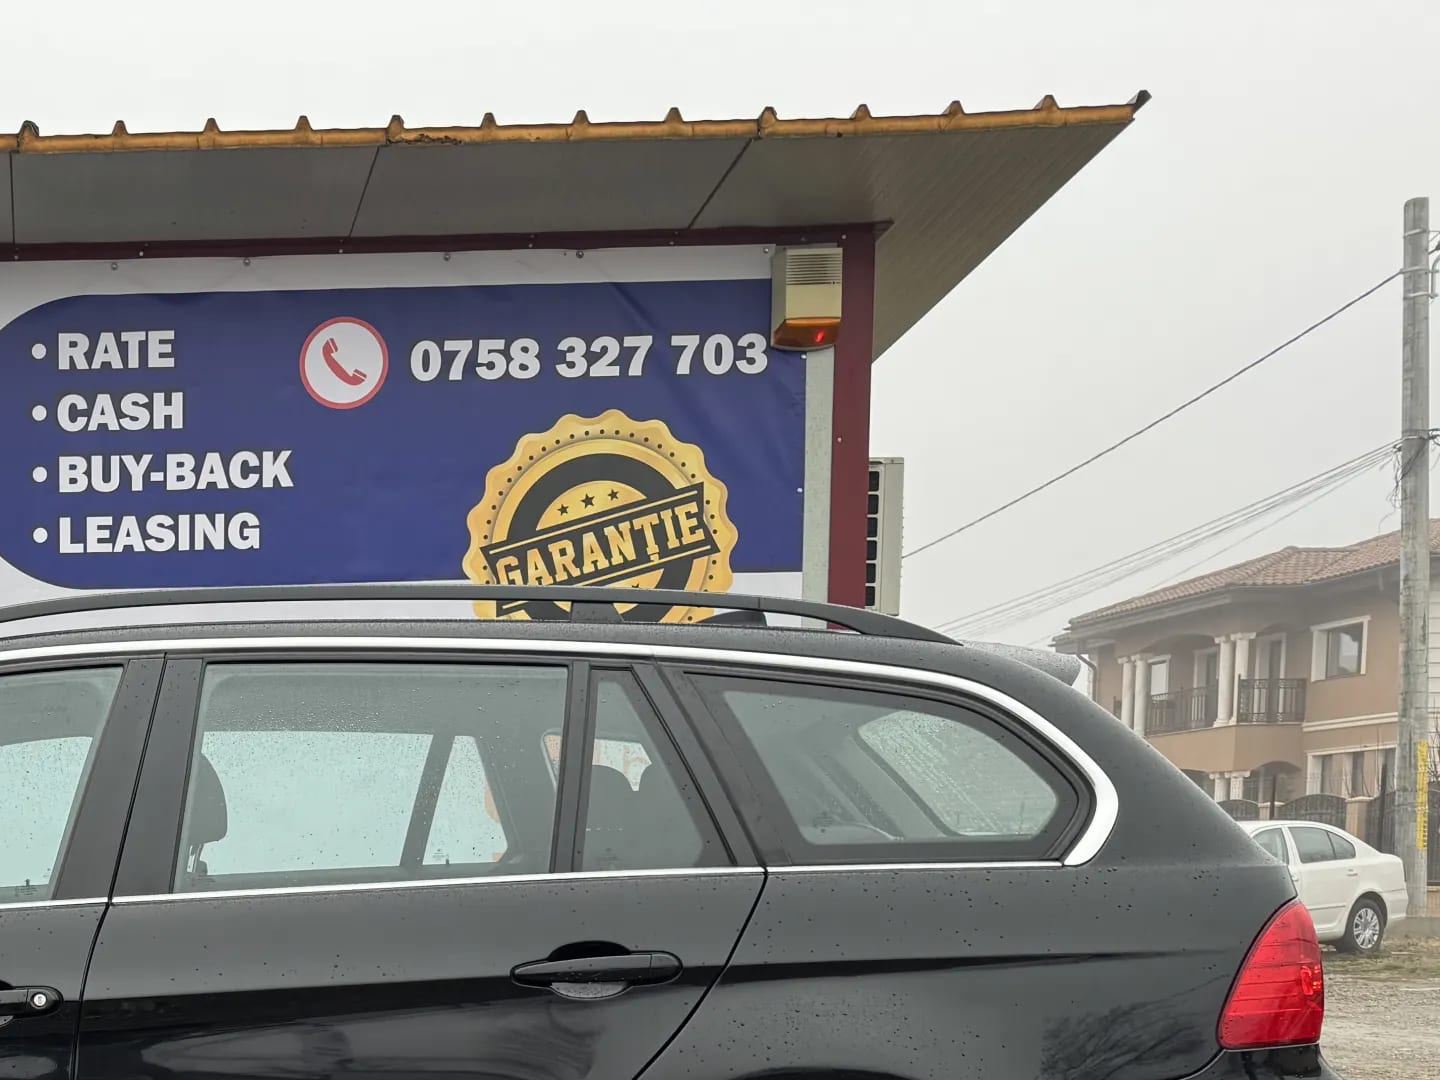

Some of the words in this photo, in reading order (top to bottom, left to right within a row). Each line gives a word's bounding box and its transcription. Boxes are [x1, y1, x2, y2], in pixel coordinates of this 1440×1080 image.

[58, 330, 175, 370] RATE
[410, 338, 540, 381] 0758
[555, 336, 653, 378] 327
[670, 333, 768, 376] 703
[57, 392, 184, 432] CASH
[59, 450, 294, 493] BUY-BACK
[60, 512, 260, 554] LEASING
